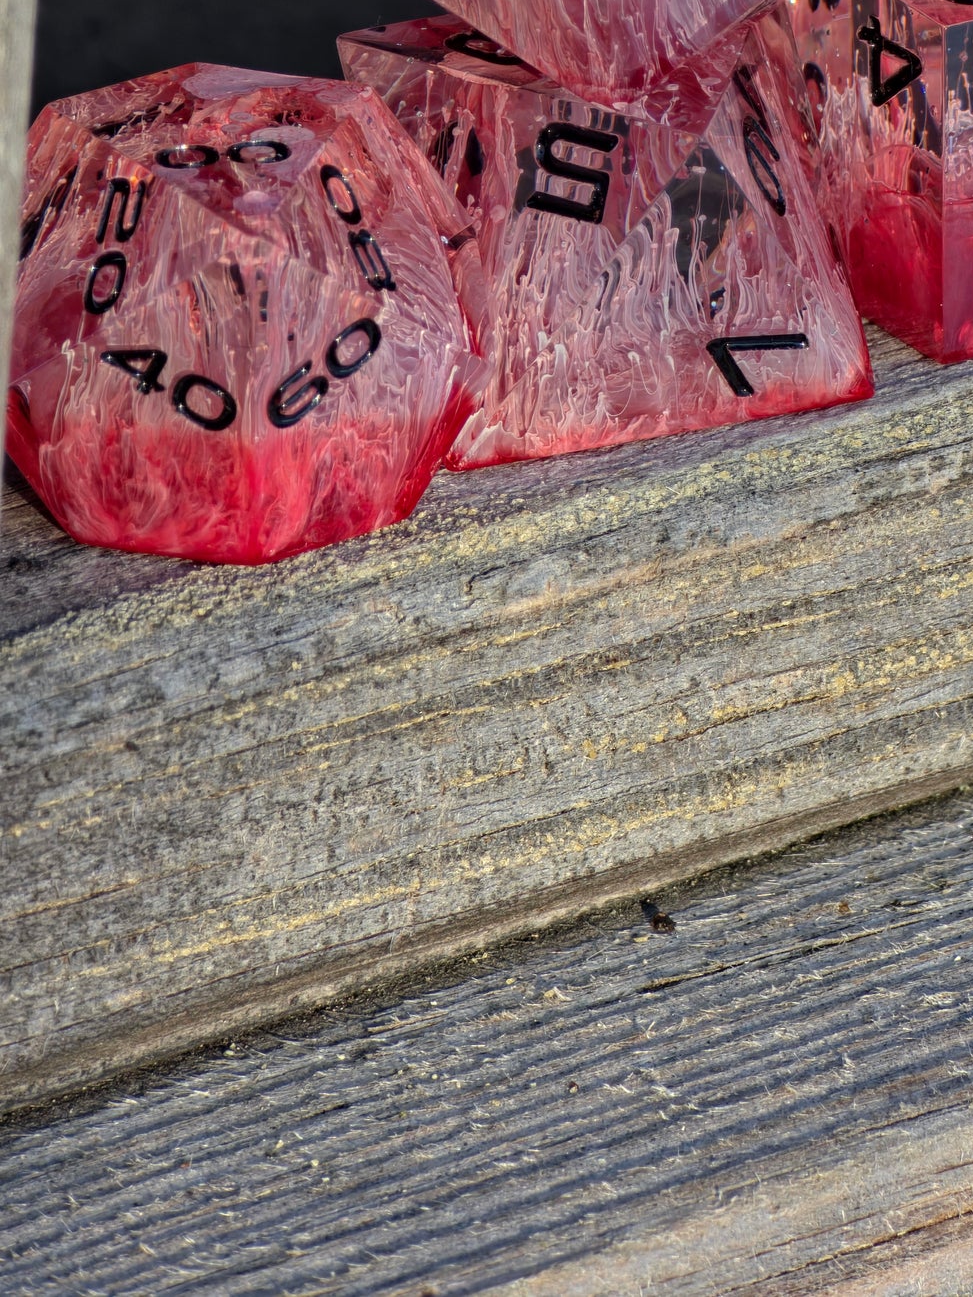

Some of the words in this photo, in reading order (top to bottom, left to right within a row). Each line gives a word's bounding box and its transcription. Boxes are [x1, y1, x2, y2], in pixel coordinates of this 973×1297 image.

[857, 16, 922, 106] 4
[102, 349, 237, 431] 40
[267, 318, 381, 429] 60
